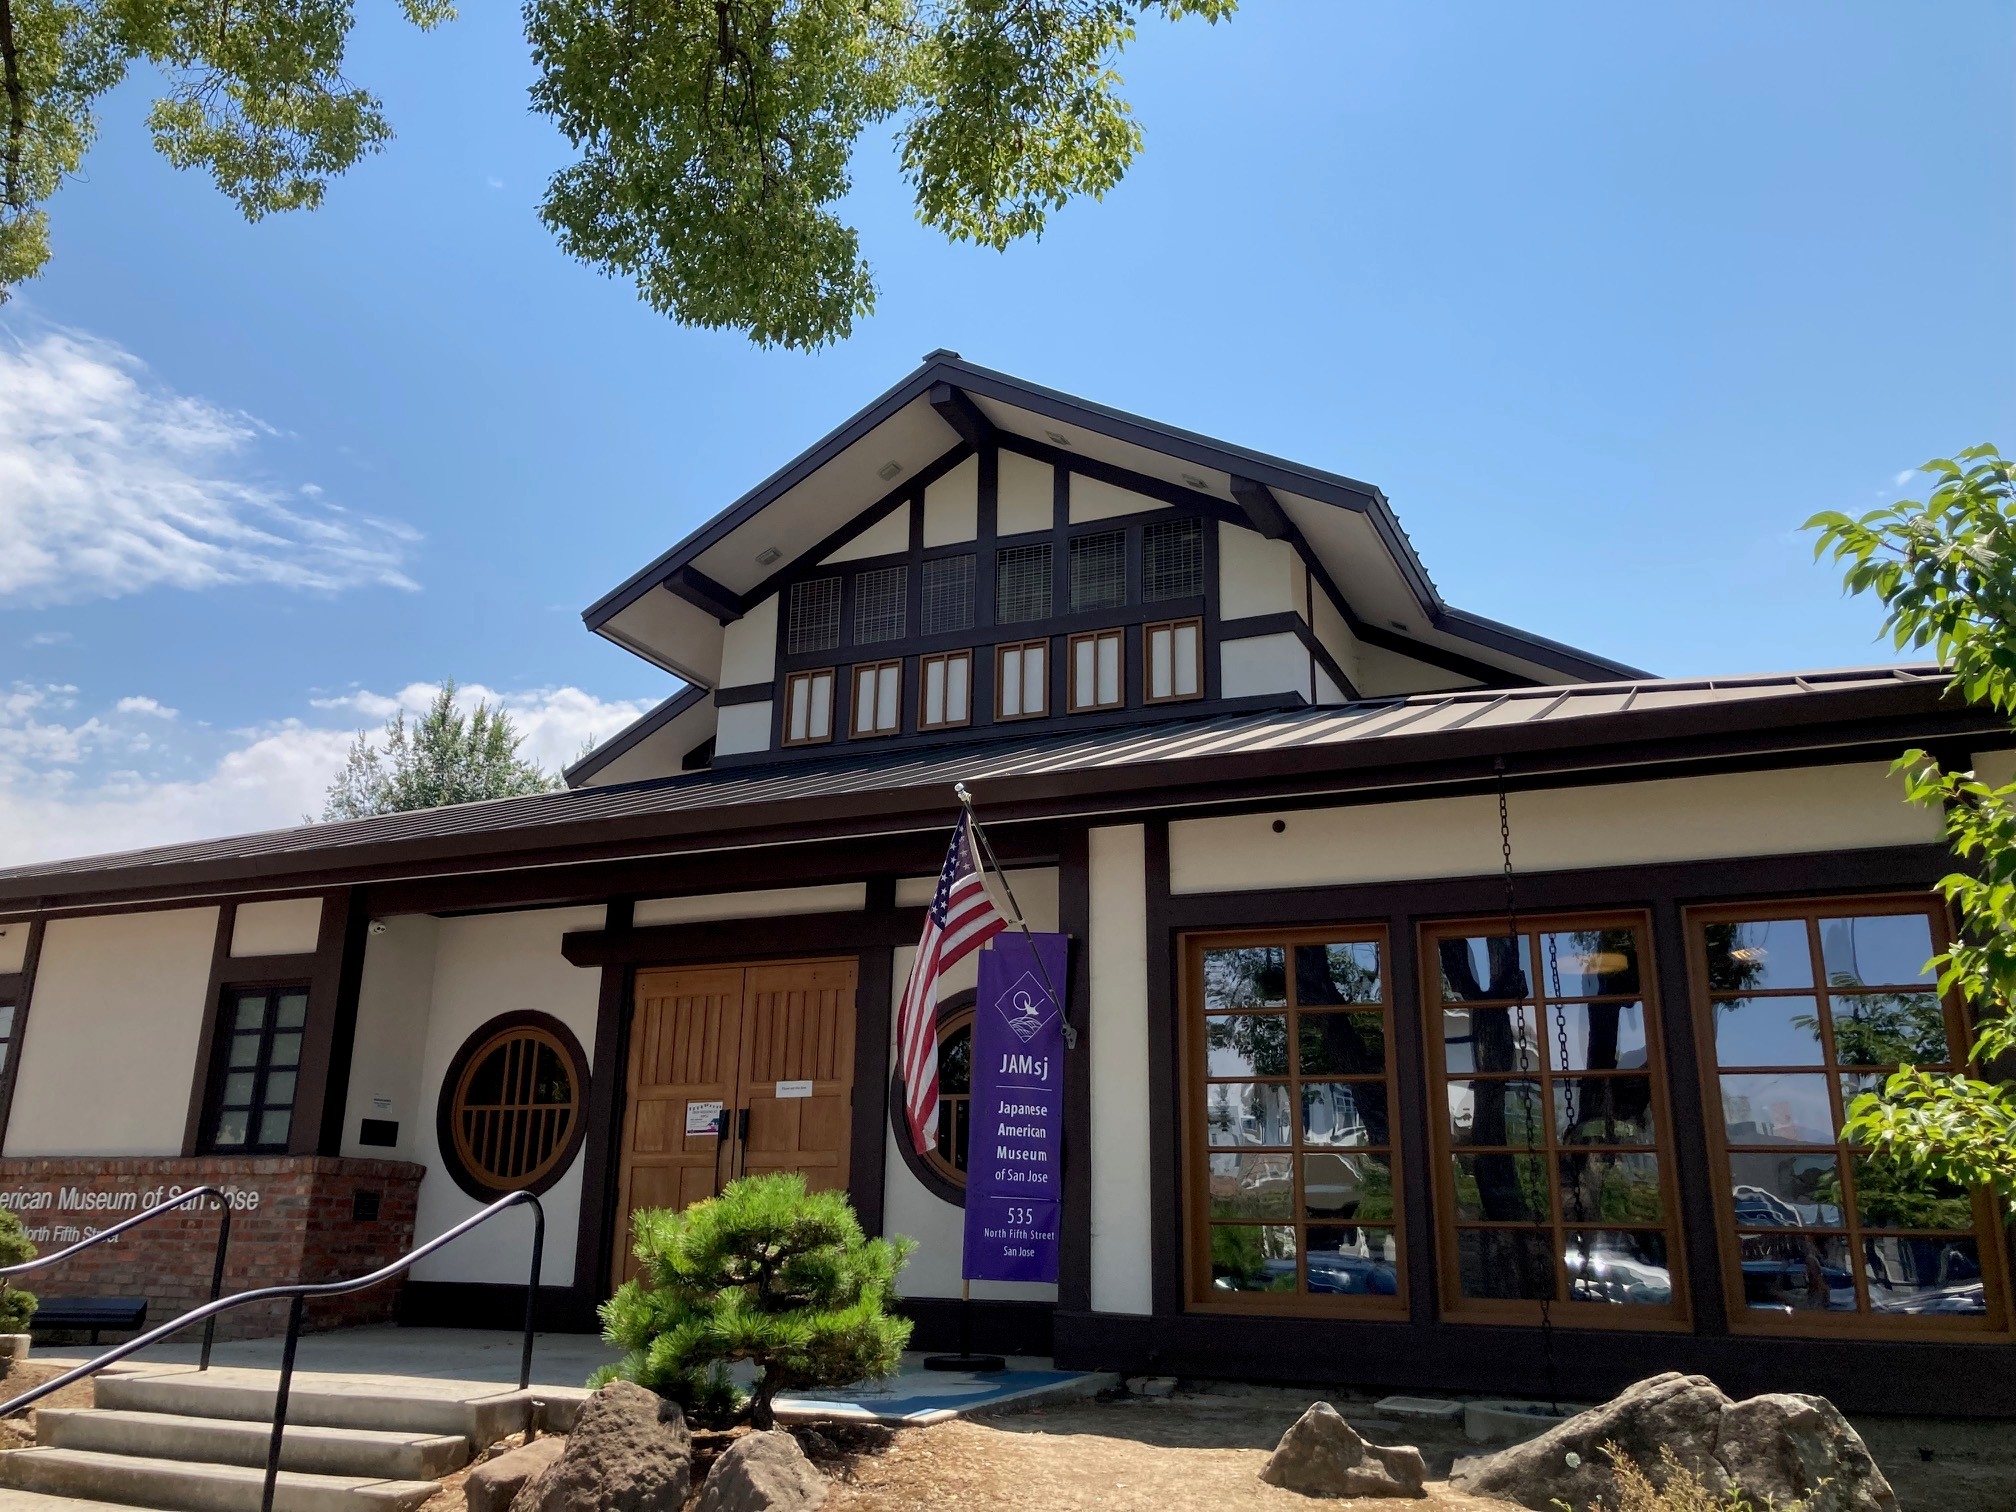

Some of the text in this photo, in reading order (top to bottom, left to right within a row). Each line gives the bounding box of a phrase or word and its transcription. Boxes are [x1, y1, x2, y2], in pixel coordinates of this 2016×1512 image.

[999, 1053, 1048, 1081] JAMsj
[998, 1100, 1048, 1117] Japanese
[997, 1122, 1046, 1138] American
[996, 1145, 1047, 1161] Museum
[995, 1168, 1048, 1183] of San Jose
[58, 1186, 138, 1210] Museum
[142, 1186, 164, 1210] of
[1007, 1207, 1033, 1225] 535
[53, 1225, 80, 1242] Fifth
[82, 1226, 119, 1243] Stet
[984, 1227, 1055, 1240] North Fifth Street
[1003, 1245, 1035, 1257] San Jose
